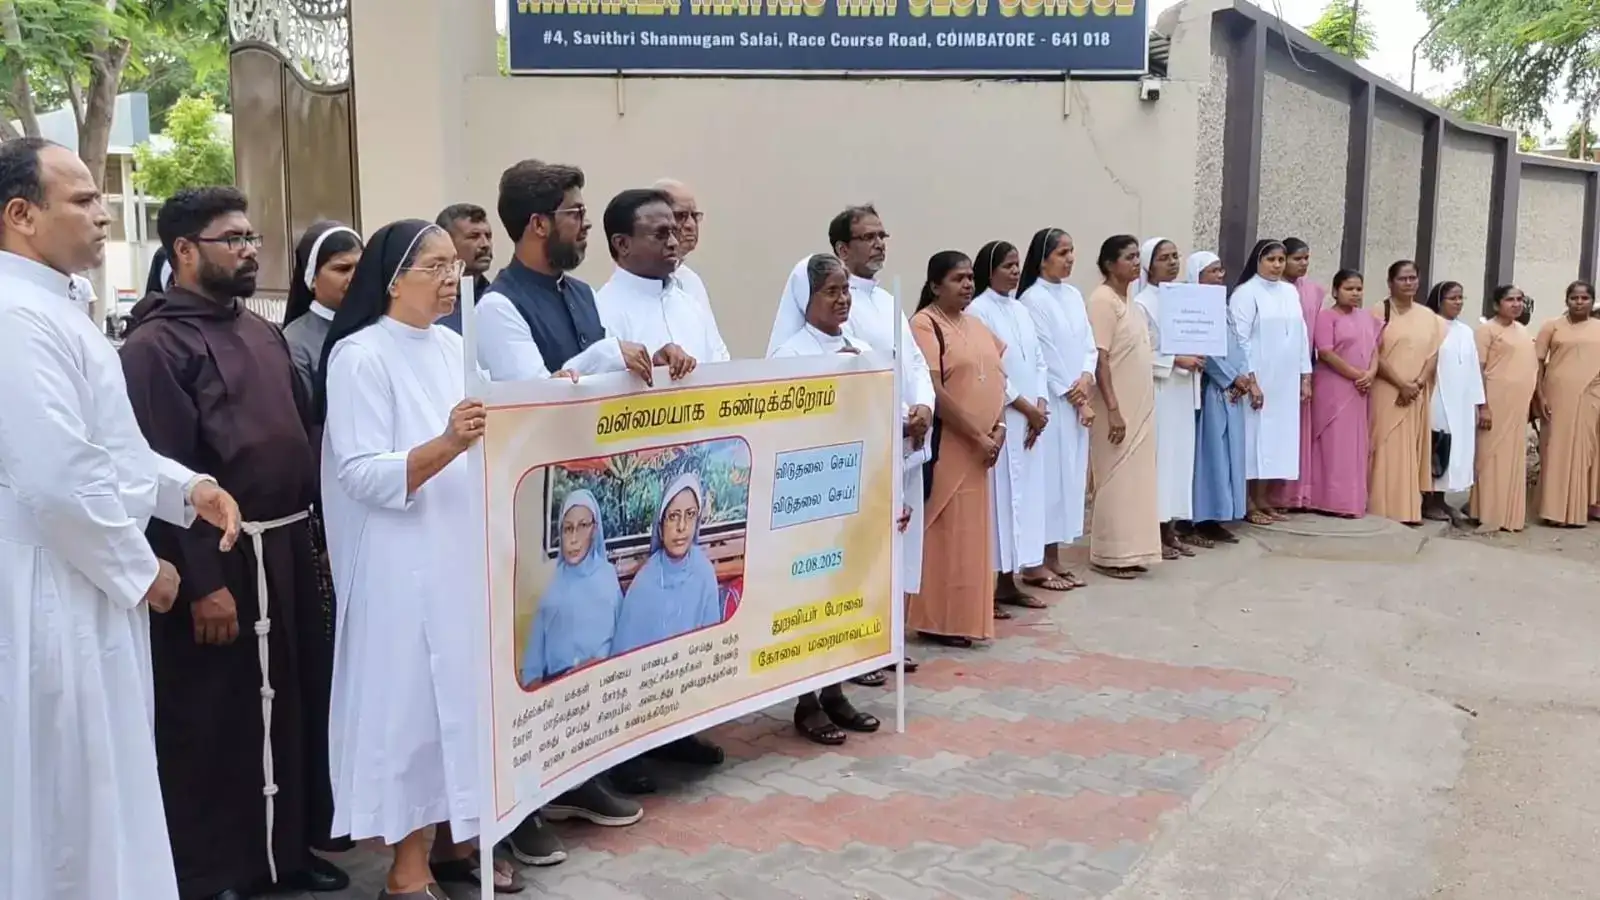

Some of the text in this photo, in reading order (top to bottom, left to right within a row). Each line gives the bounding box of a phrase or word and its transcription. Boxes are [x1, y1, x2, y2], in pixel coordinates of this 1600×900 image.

[543, 30, 568, 46] #4,
[574, 30, 635, 45] Savithri
[641, 31, 734, 48] Shanmugam
[740, 32, 783, 48] Salai,
[788, 32, 825, 46] Race
[831, 33, 883, 47] Course
[889, 32, 931, 48] Road,
[936, 31, 1035, 47] COIMBATORE
[1052, 32, 1078, 46] 641
[1084, 32, 1110, 46] 018
[597, 385, 836, 435] வன்மையாக கண்டிக்கிறோம்
[776, 453, 858, 481] விடுதலை செய்!
[773, 485, 855, 514] விடுதலை செய்!
[792, 552, 842, 575] 02.08.2025
[772, 597, 864, 636] துறவியர் பேரவை
[689, 641, 713, 656] செய்து
[722, 633, 739, 646] வந்த
[758, 618, 881, 666] கோவை மறைமாவட்டம்
[539, 735, 559, 752] கைது
[566, 720, 590, 738] செய்து
